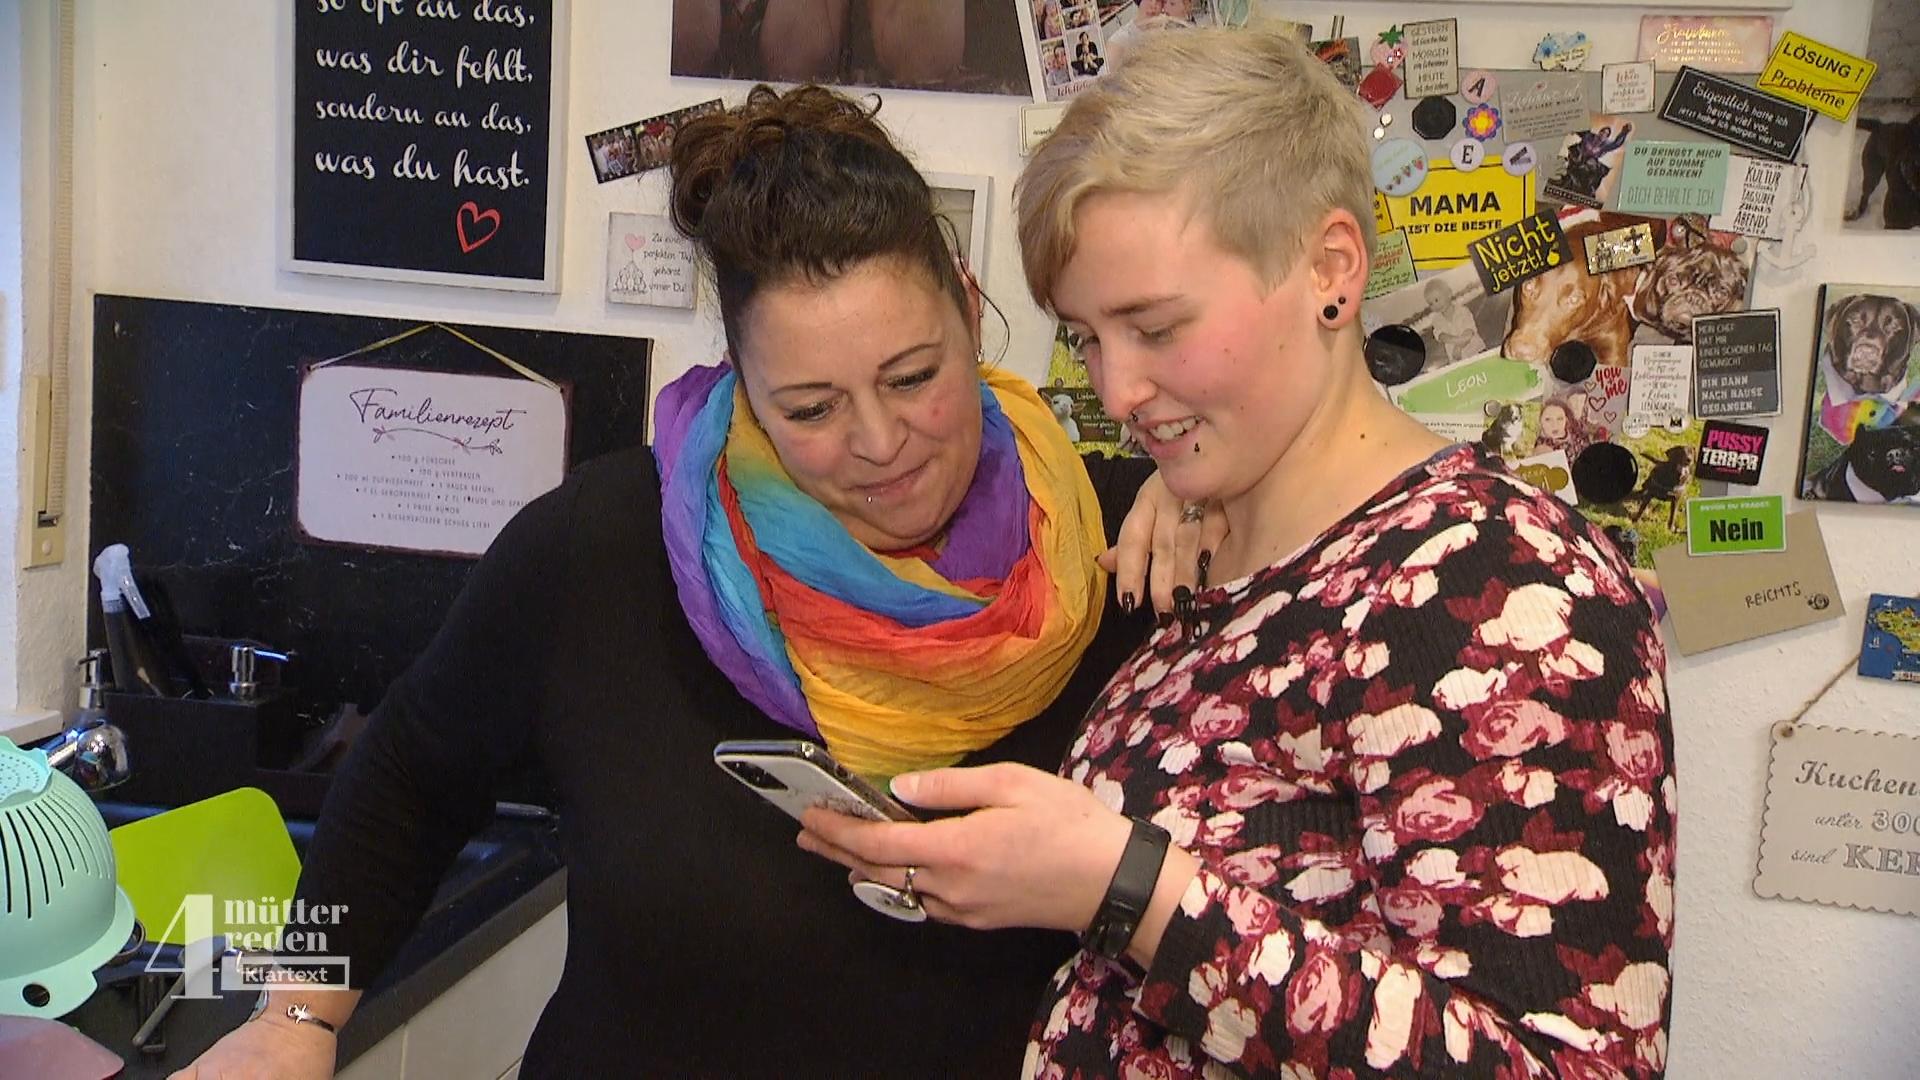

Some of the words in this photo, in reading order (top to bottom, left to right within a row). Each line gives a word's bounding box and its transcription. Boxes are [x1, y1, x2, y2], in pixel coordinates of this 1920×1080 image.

[416, 0, 460, 19] an
[473, 0, 534, 28] das,
[316, 48, 372, 75] was
[387, 41, 444, 77] dir
[456, 45, 533, 89] fehlt,
[1783, 41, 1852, 79] LÖSUNG
[1468, 77, 1486, 98] A
[1771, 68, 1845, 109] Probleme
[316, 92, 423, 125] sondern
[434, 112, 471, 128] an
[481, 102, 532, 135] das,
[1692, 81, 1750, 114] Eigentlich
[1775, 113, 1789, 127] ich
[1706, 103, 1733, 121] heute
[1734, 114, 1752, 127] viel
[1462, 145, 1474, 165] E
[1634, 147, 1647, 156] DU
[1651, 147, 1693, 158] BRINGST
[1696, 148, 1722, 158] MICH
[1647, 158, 1667, 167] AUF
[1669, 158, 1706, 168] DUMME
[315, 151, 377, 180] was
[392, 143, 441, 181] du
[453, 149, 530, 190] hast.
[1410, 191, 1501, 217] MAMA
[1408, 223, 1430, 235] IST
[1434, 221, 1457, 233] DIE
[1475, 215, 1556, 271] Nicht
[1490, 249, 1546, 293] jetzt!
[1758, 343, 1774, 353] TAG
[1595, 366, 1621, 390] you
[1605, 378, 1628, 399] me
[1701, 378, 1718, 388] BIN
[1720, 375, 1749, 387] DANN
[1701, 389, 1728, 401] NACH
[1730, 387, 1764, 399] HAUSE
[350, 387, 527, 434] Familienrezept
[1706, 429, 1764, 454] PUSSY
[1709, 518, 1764, 543] Nein
[1814, 812, 1863, 829] unter
[1791, 848, 1838, 865] sind
